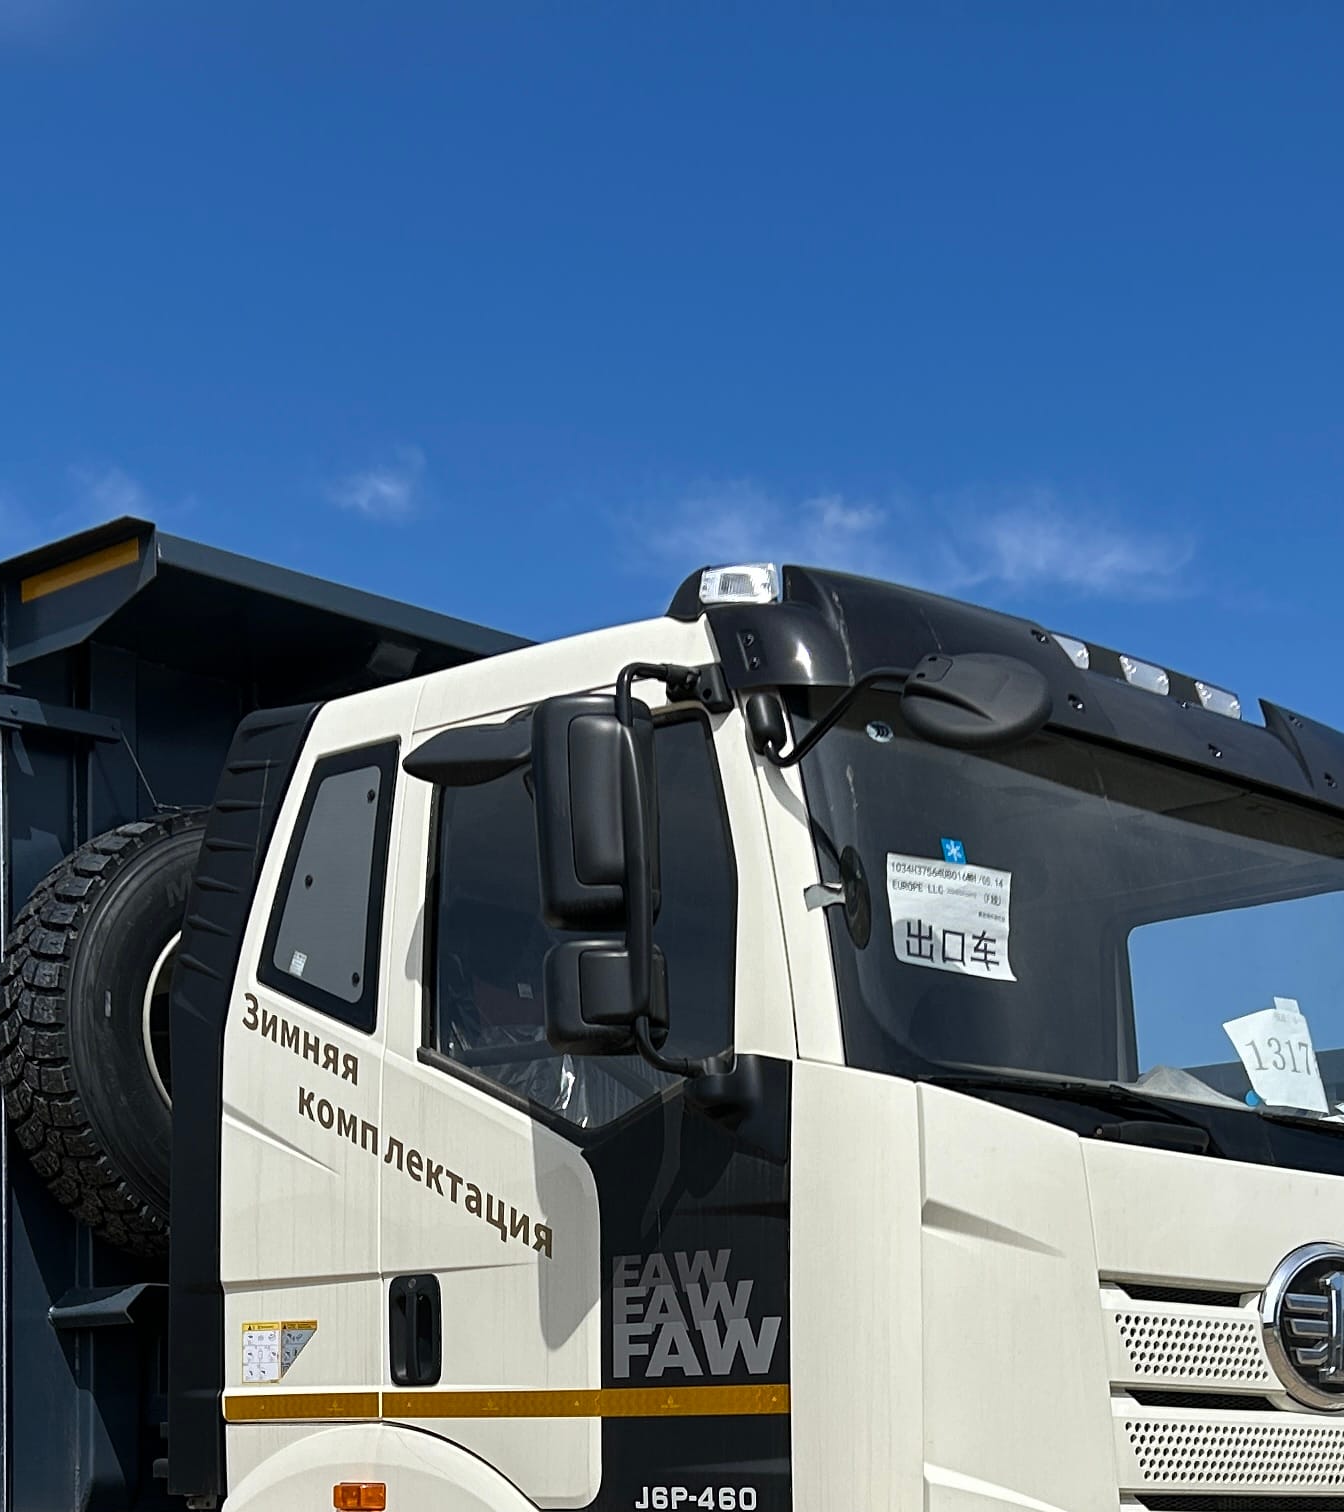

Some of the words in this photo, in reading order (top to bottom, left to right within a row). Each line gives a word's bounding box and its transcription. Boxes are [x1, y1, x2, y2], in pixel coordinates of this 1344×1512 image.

[905, 919, 1000, 971] 出口车
[242, 992, 359, 1087] Зимняя
[297, 1085, 553, 1259] комплектация
[612, 1316, 782, 1379] FAW
[635, 1486, 757, 1511] J6P-460
